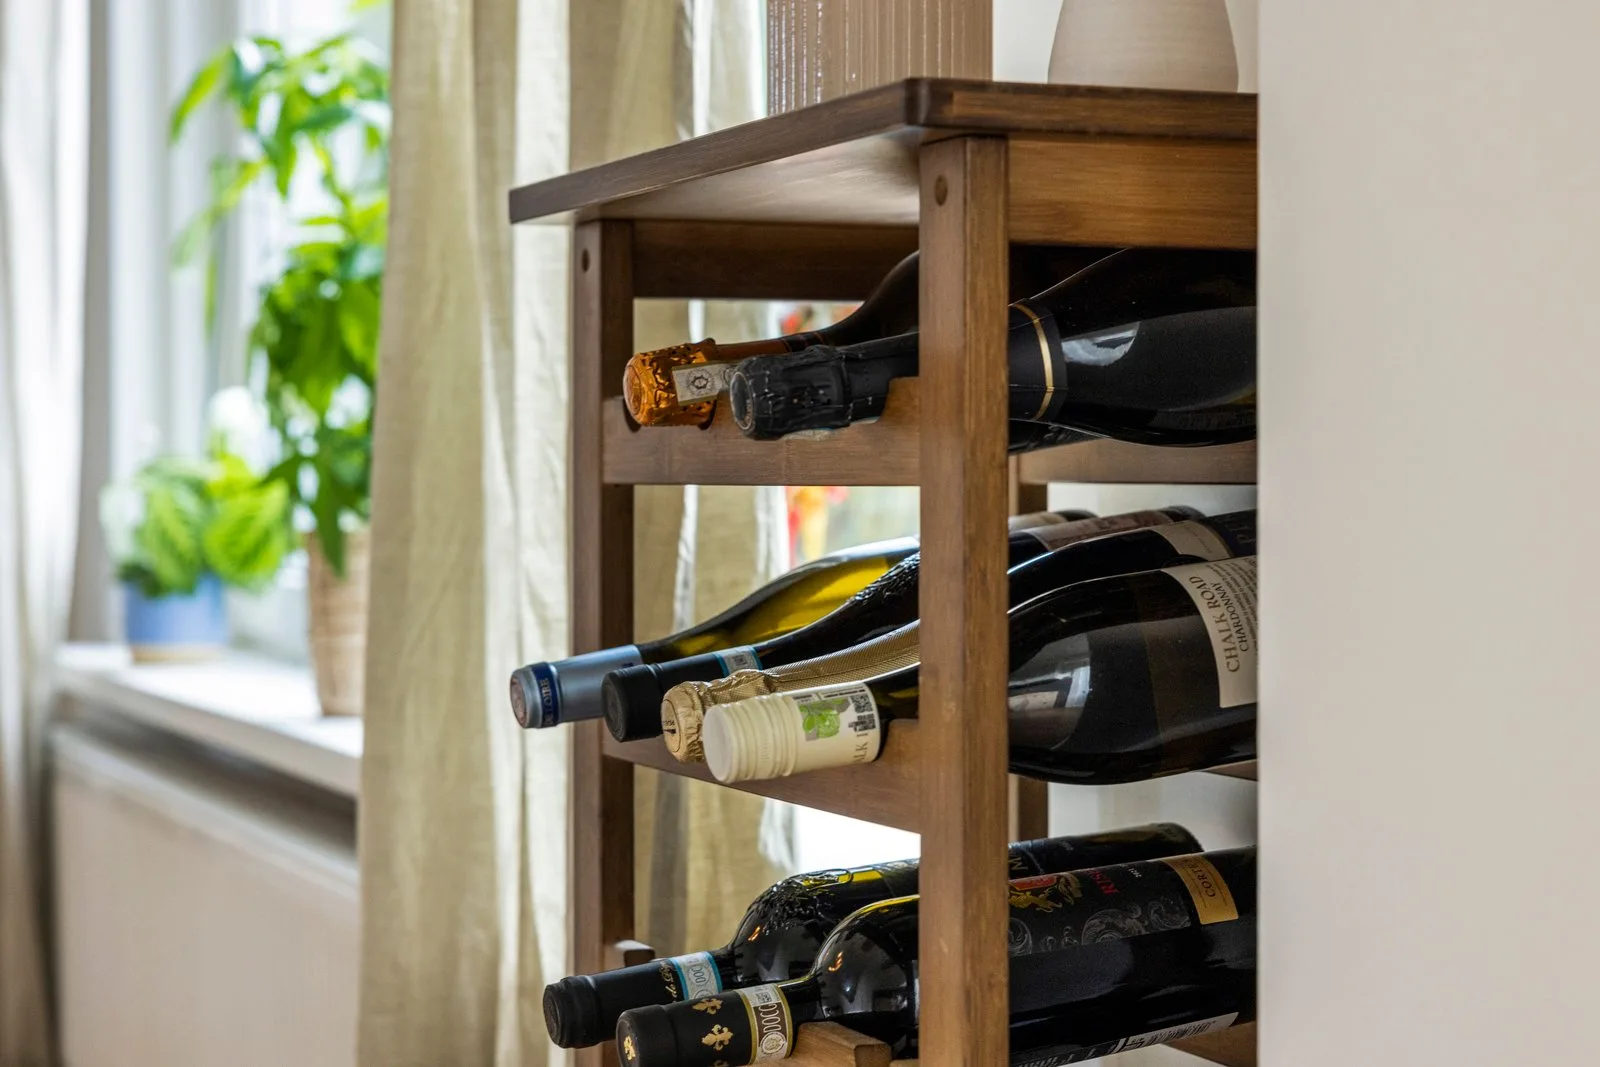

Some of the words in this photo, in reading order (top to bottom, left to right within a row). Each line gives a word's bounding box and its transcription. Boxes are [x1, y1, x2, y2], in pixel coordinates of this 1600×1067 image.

[1189, 576, 1221, 609] ROAD
[1211, 582, 1249, 652] CHARDONNAY
[1213, 612, 1240, 672] CHALK
[691, 963, 706, 985] DOC
